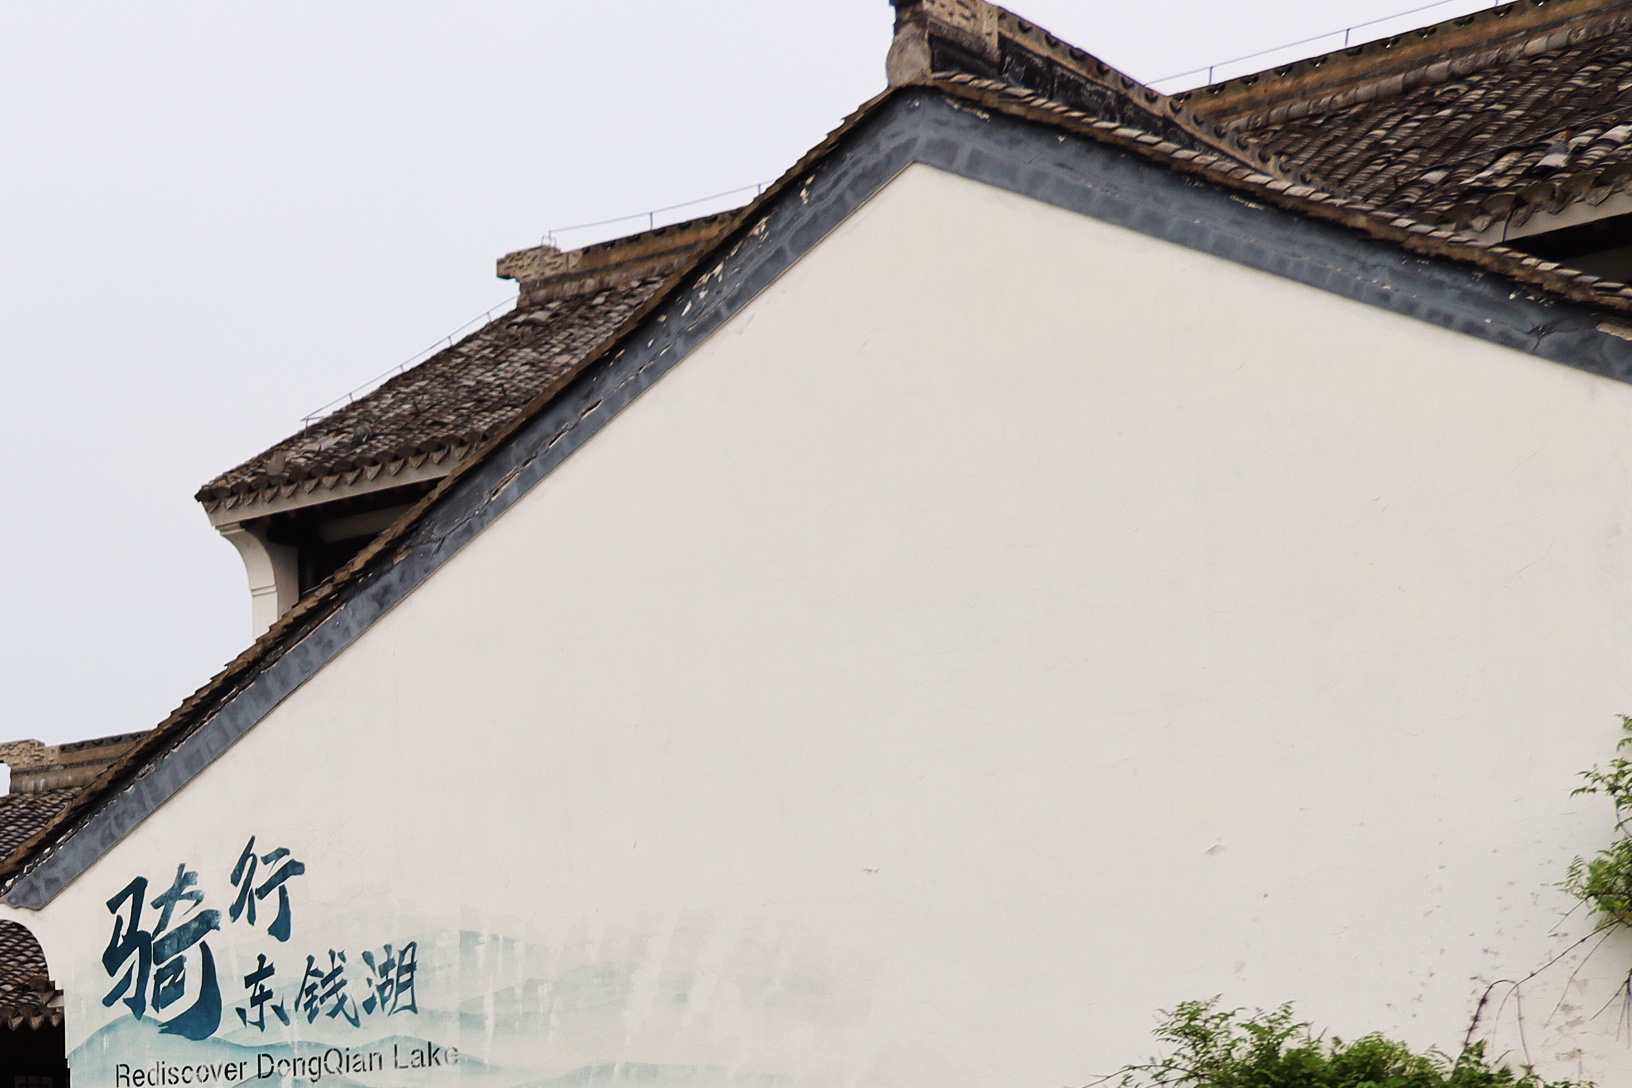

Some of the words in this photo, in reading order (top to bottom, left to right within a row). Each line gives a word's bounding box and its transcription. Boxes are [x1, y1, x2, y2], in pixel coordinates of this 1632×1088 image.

[102, 835, 305, 1041] 骑行
[235, 941, 420, 1033] 东钱湖
[114, 1057, 248, 1088] Rediscover
[256, 1047, 384, 1084] DongQian
[393, 1041, 460, 1071] Lake
